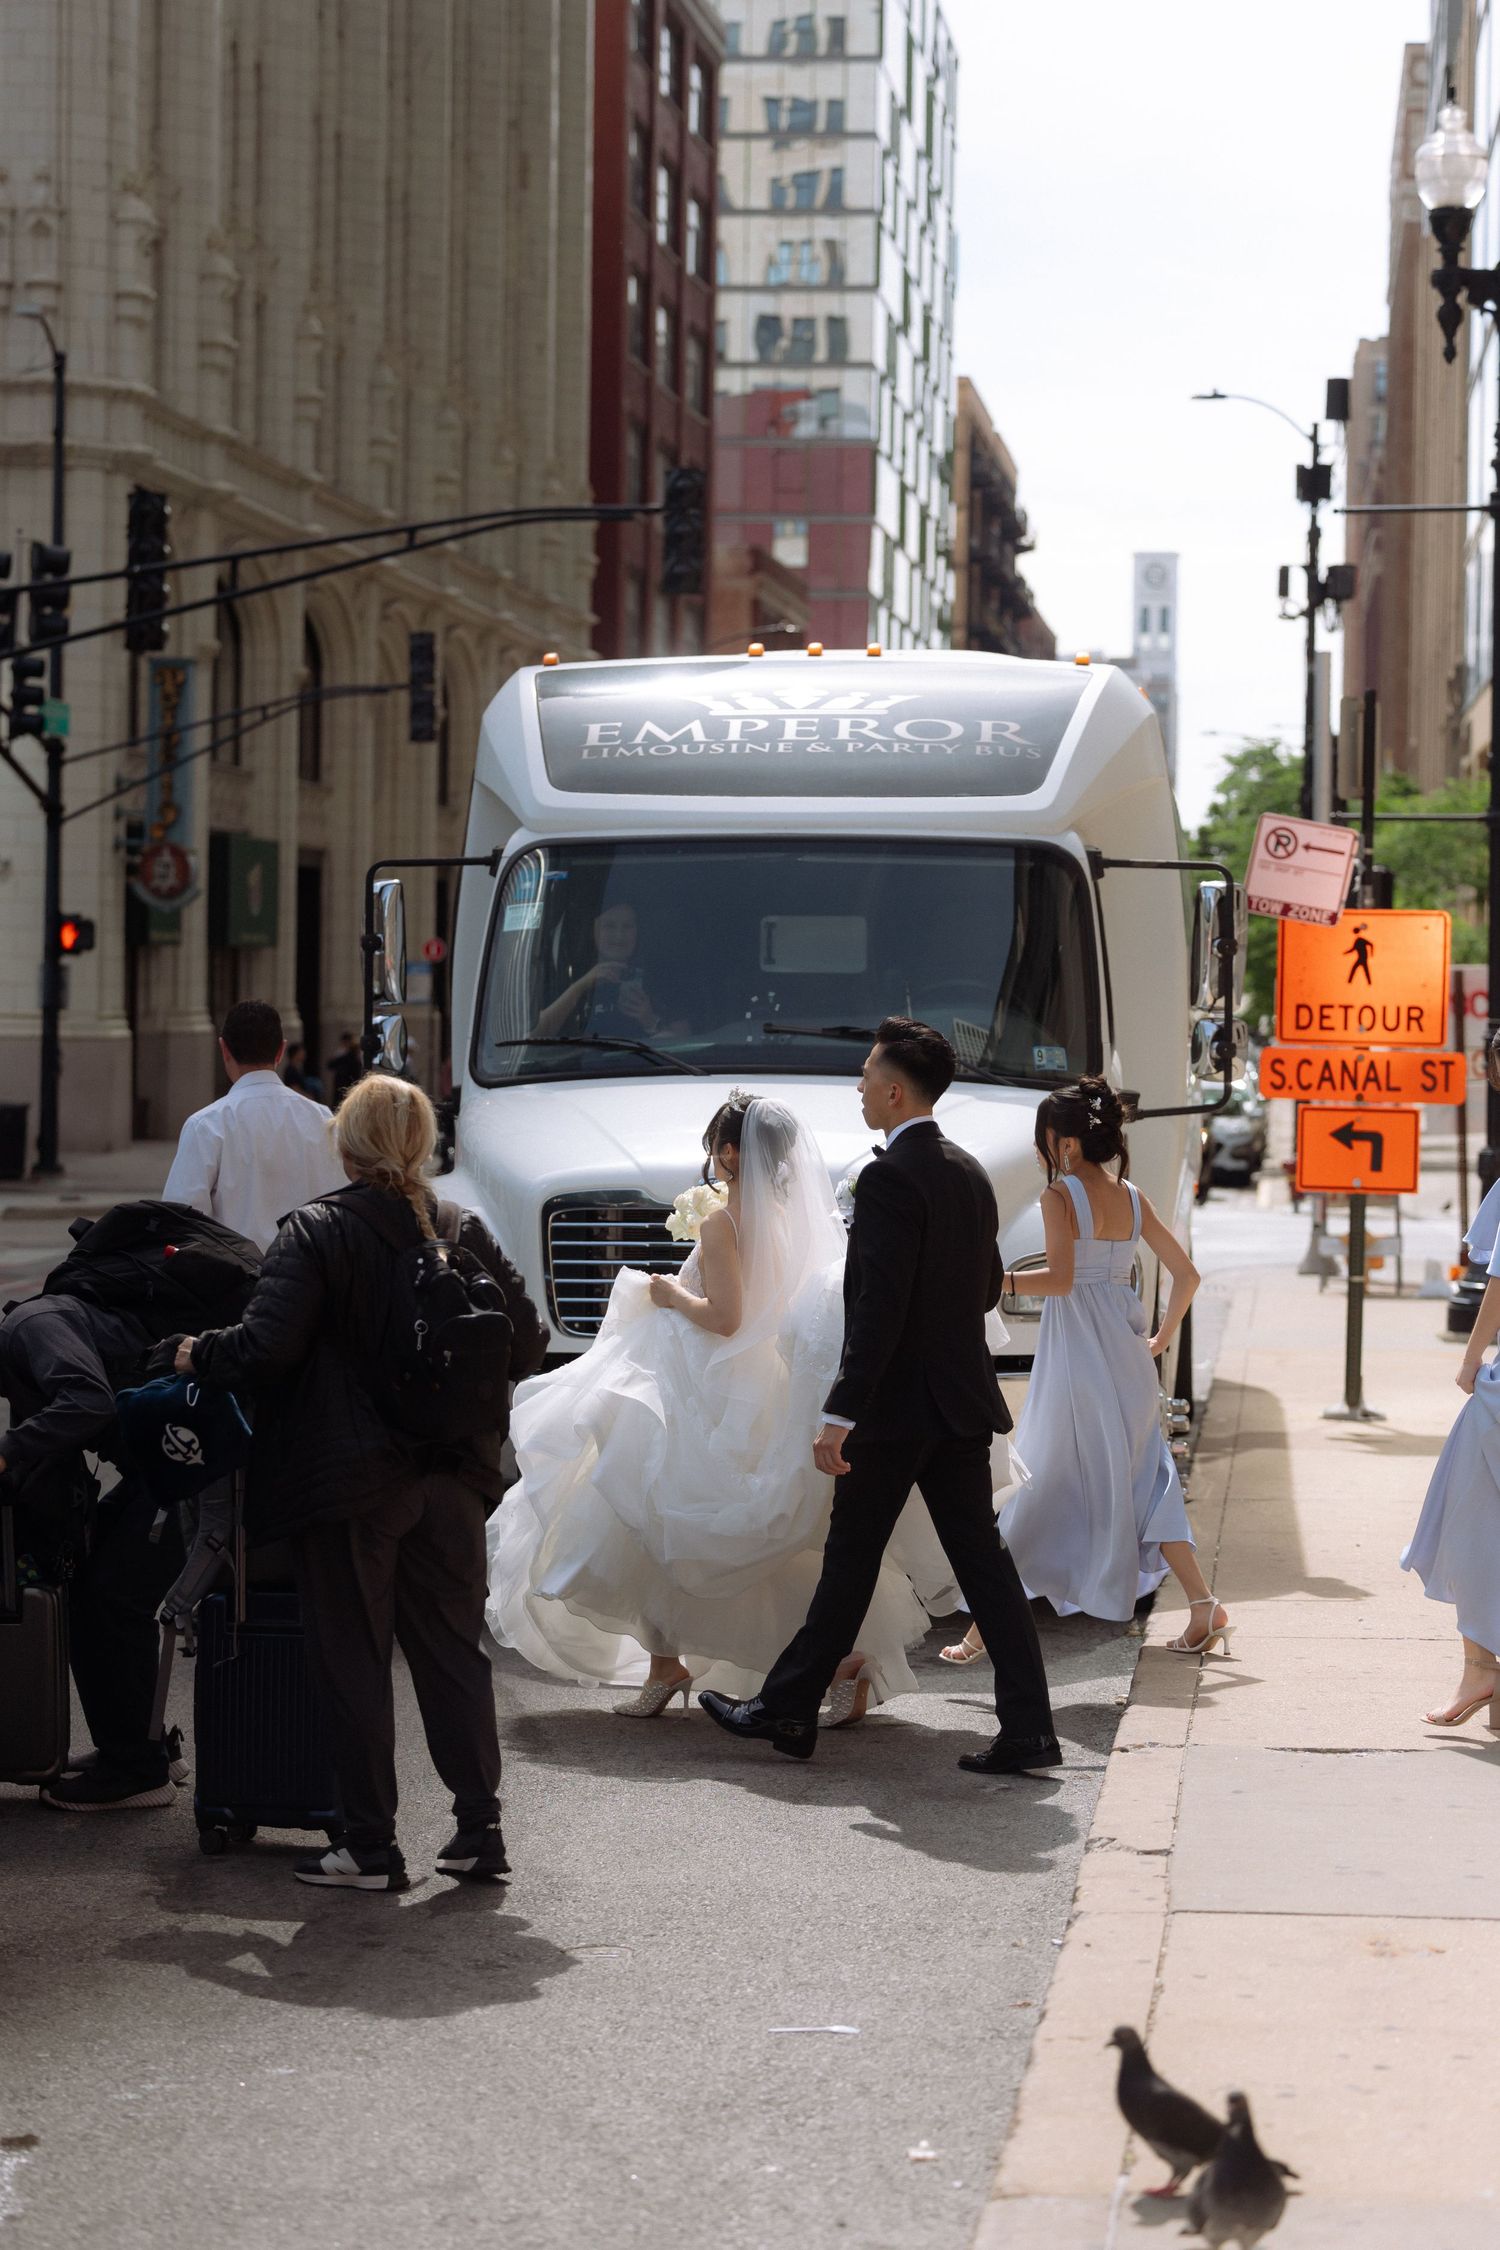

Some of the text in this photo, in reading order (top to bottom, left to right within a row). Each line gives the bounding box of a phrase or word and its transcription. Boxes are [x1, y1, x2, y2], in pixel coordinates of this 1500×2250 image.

[581, 717, 1038, 746] EMPEROR
[581, 741, 1041, 760] LIMOUSINE & PARTY BUS
[1250, 896, 1333, 923] TOW ZONE
[1295, 1004, 1424, 1032] DETOUR
[1036, 1049, 1044, 1063] 9
[1269, 1058, 1402, 1091] S.CANAL
[1420, 1060, 1455, 1092] ST
